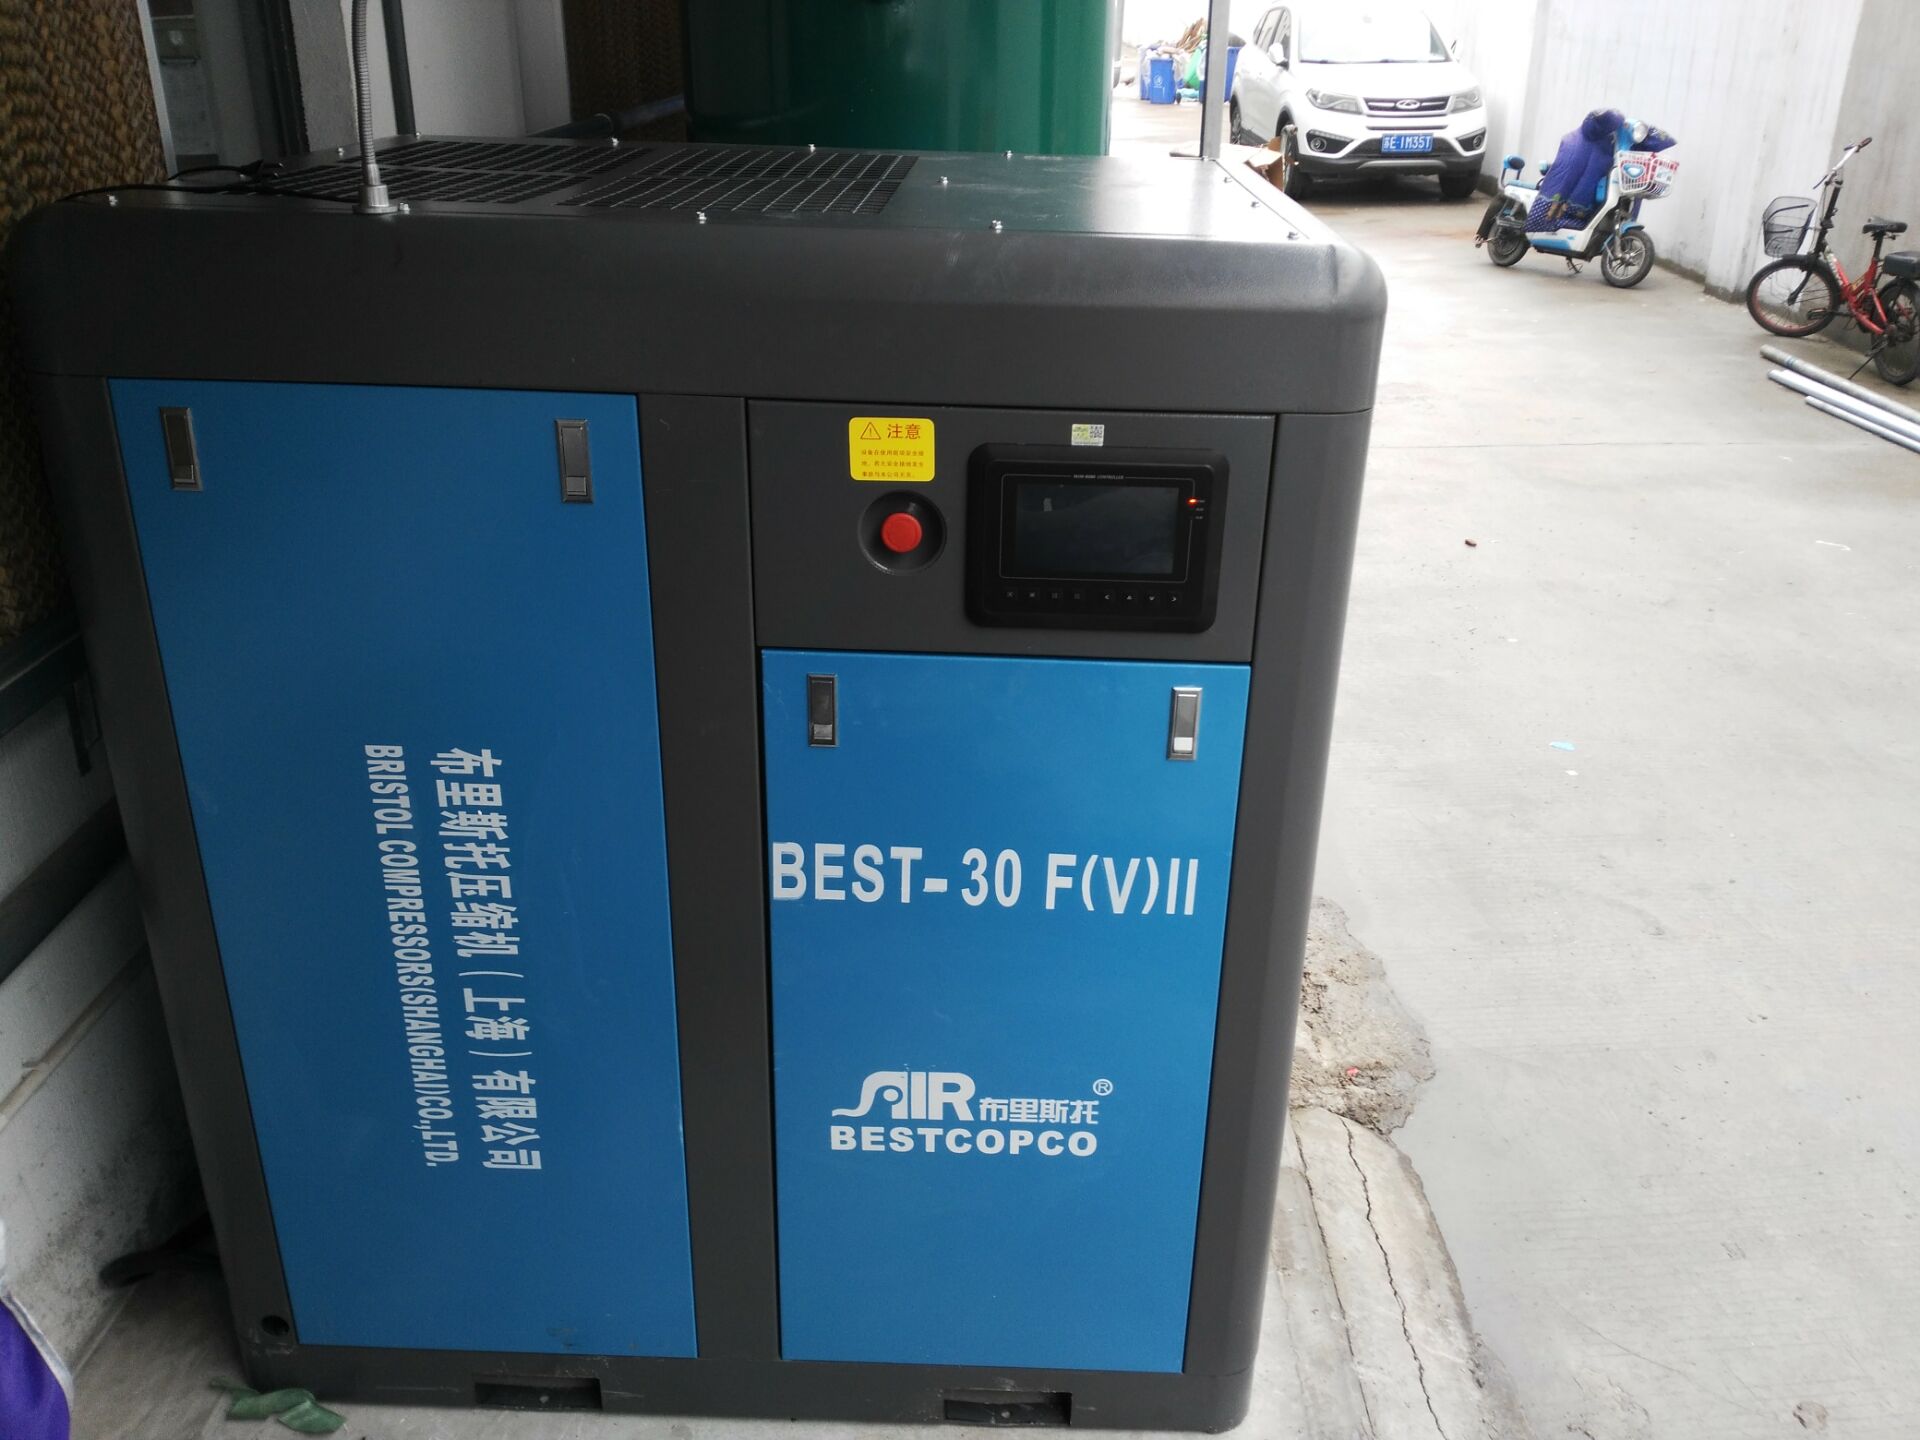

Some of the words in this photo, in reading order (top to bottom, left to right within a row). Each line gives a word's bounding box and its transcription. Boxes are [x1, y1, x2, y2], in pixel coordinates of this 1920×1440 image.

[887, 423, 921, 440] 注意
[365, 744, 414, 834] BRISTOL
[961, 848, 1022, 907] 30
[979, 1097, 1099, 1125] 布里斯托
[830, 1126, 1098, 1157] BESTCOPCO
